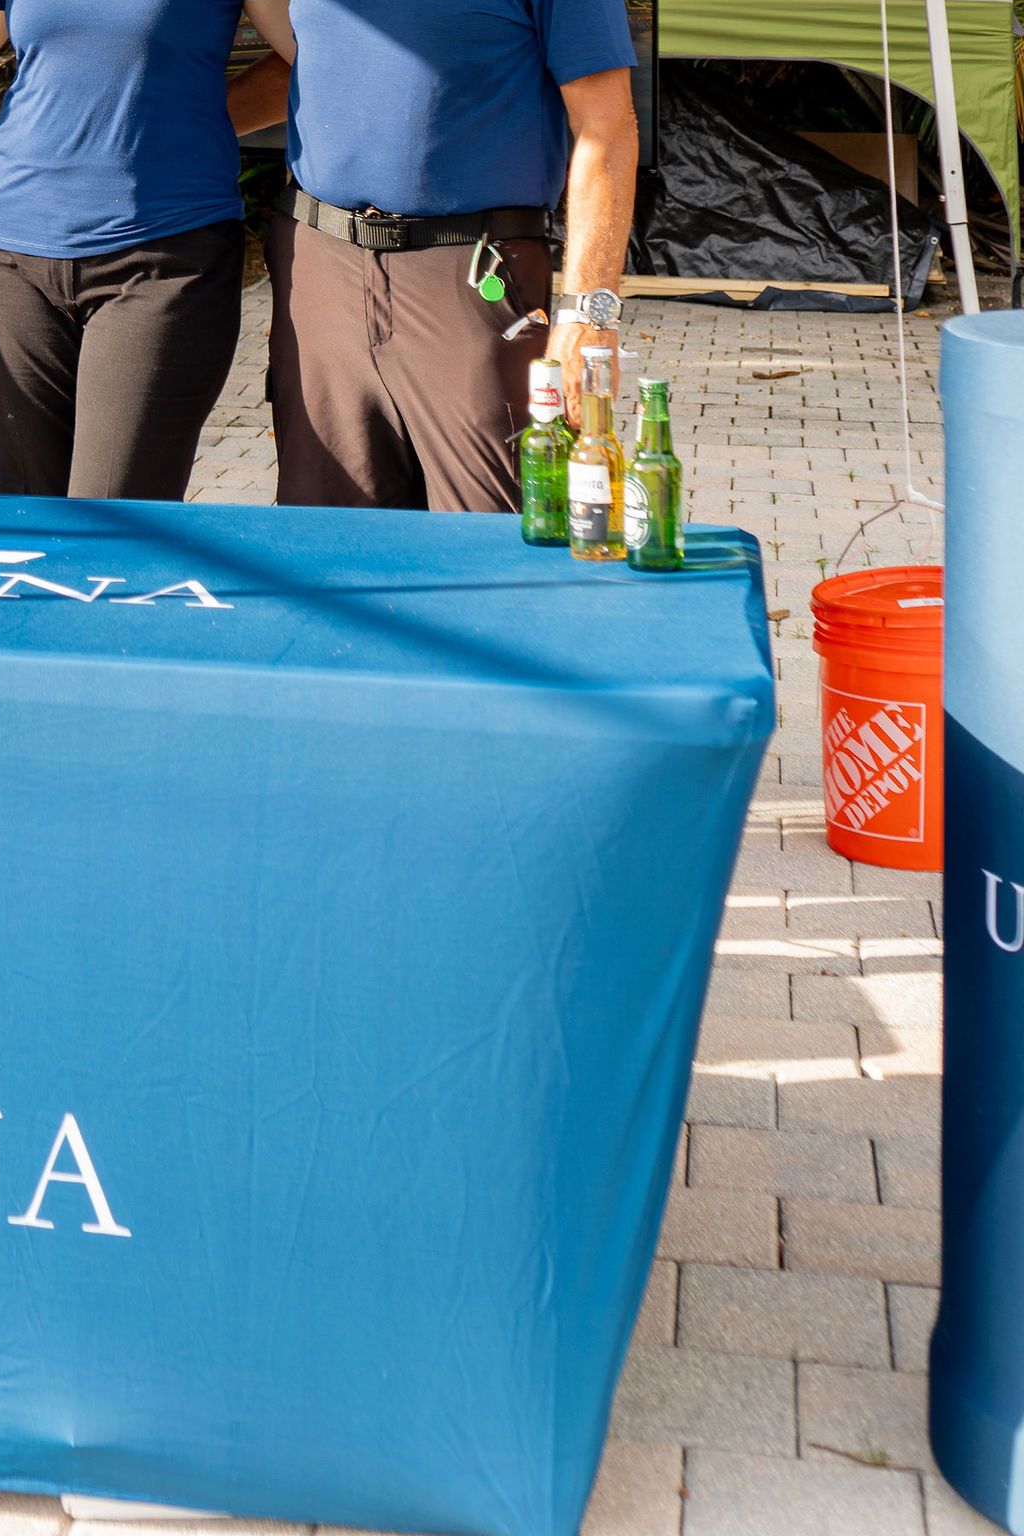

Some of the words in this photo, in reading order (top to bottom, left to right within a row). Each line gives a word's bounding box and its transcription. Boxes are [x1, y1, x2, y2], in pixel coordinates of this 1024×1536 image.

[825, 707, 856, 754] THE
[825, 702, 925, 821] HOME
[843, 753, 923, 831] DEPOT
